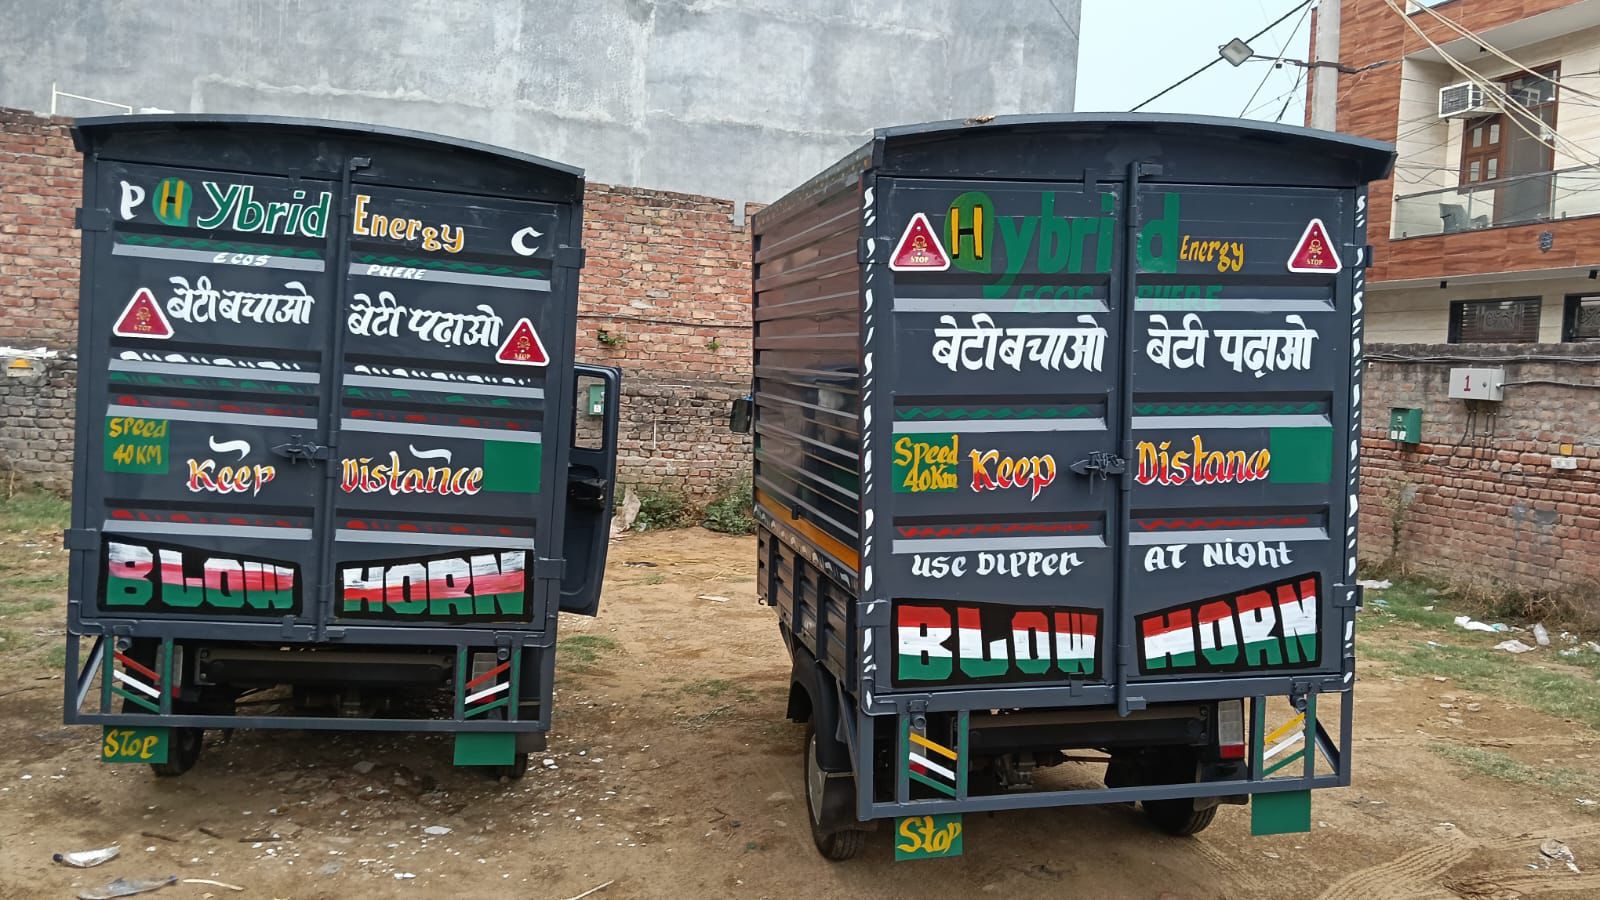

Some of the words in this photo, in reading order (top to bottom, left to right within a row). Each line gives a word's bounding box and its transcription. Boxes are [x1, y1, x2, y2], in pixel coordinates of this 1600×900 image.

[353, 194, 465, 254] Energy
[910, 255, 929, 263] STOP
[1180, 235, 1245, 273] Energy
[1306, 258, 1324, 266] STOP
[166, 275, 221, 323] बेटी
[218, 280, 316, 324] बचाओ
[347, 290, 408, 338] बेटी
[931, 312, 1004, 373] बेटी
[998, 314, 1109, 373] बचाओ
[1145, 312, 1210, 370] बेटी
[1463, 375, 1471, 391] 1
[113, 443, 135, 466] 40
[136, 444, 162, 465] KM
[186, 458, 276, 497] Keep
[341, 450, 484, 496] Distance
[893, 434, 959, 476] Speed
[968, 448, 1058, 502] Keep
[1133, 434, 1272, 486] Distance
[106, 541, 294, 607] BLOW
[343, 550, 526, 616] HORN
[897, 603, 1099, 682] BLOW
[1143, 577, 1318, 671] HORN
[896, 815, 962, 854] Stop
